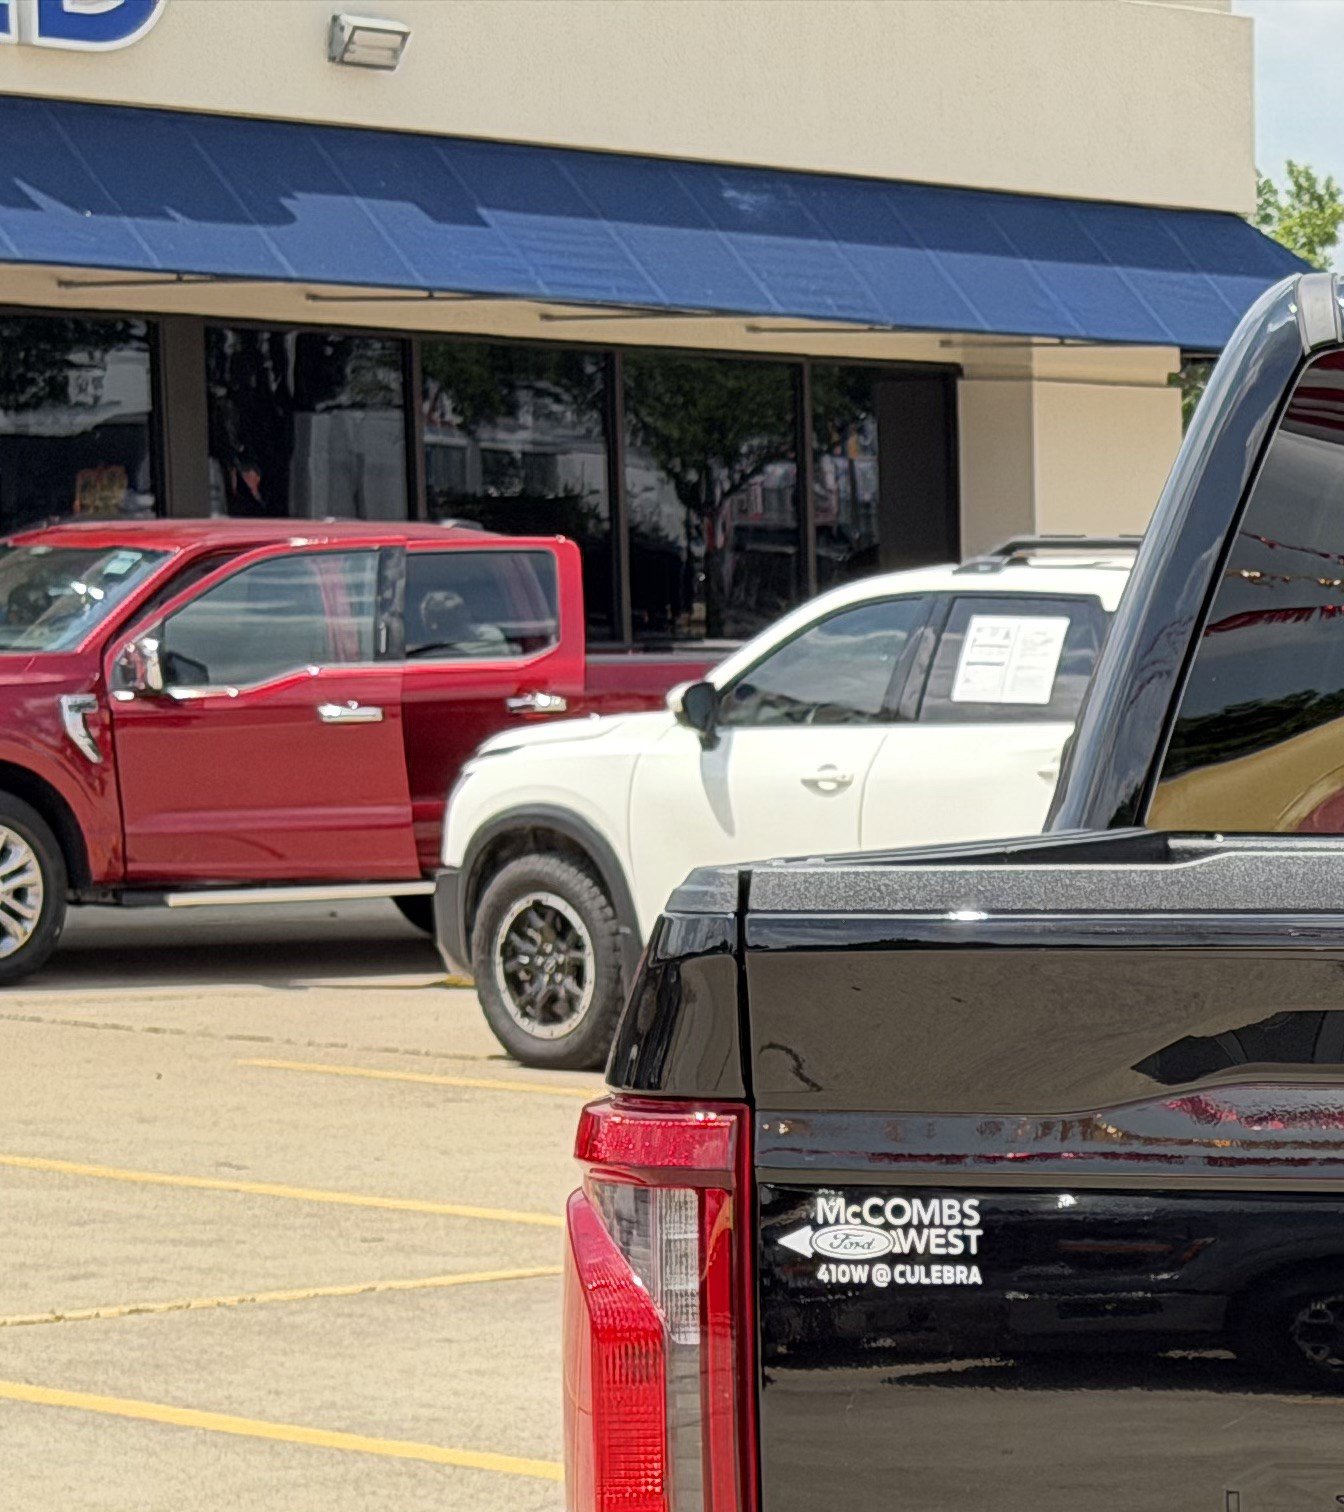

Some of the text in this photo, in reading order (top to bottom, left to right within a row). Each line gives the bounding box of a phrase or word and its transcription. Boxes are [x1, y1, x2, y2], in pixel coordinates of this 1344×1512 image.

[815, 1196, 981, 1227] McCOMBS
[829, 1232, 876, 1251] Ford
[890, 1228, 984, 1255] WEST
